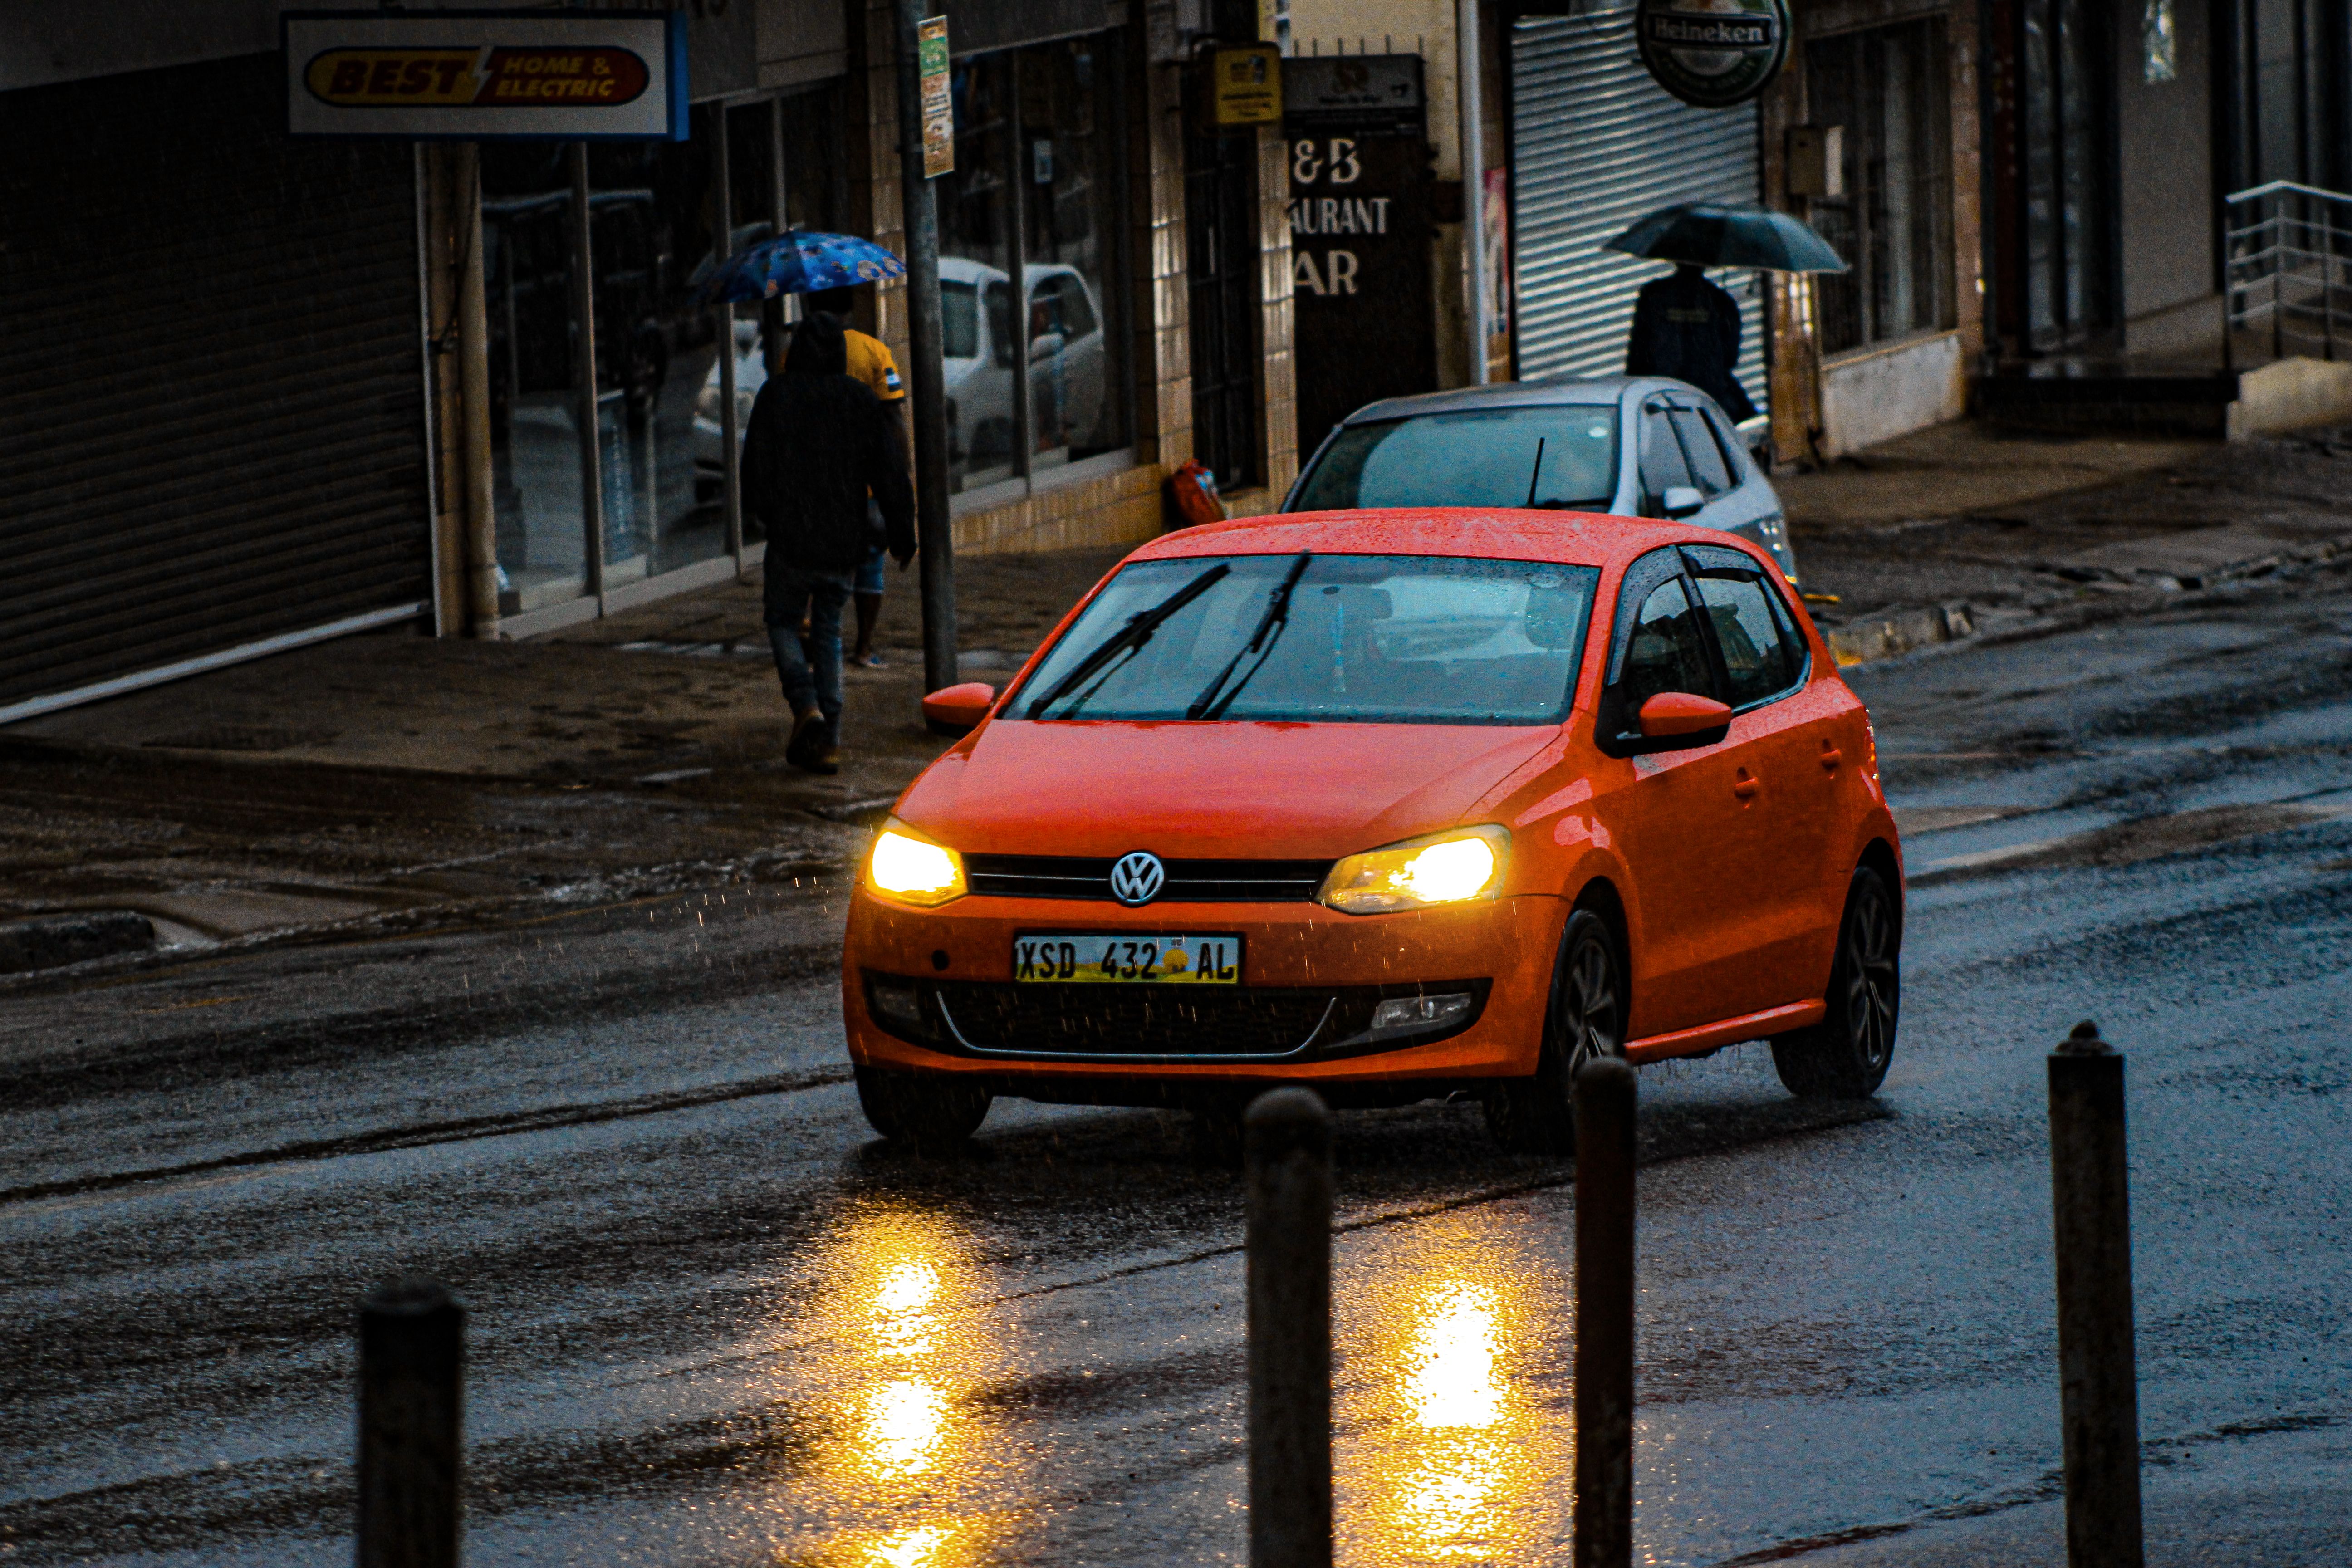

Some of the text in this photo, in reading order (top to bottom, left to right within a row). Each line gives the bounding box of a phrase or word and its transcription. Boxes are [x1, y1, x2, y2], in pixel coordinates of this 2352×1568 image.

[1653, 15, 1765, 43] Heineken
[328, 60, 469, 94] BEST
[503, 56, 612, 74] HOME &
[495, 78, 617, 97] ELECTRIC
[1020, 941, 1234, 980] XSD 432 AL
